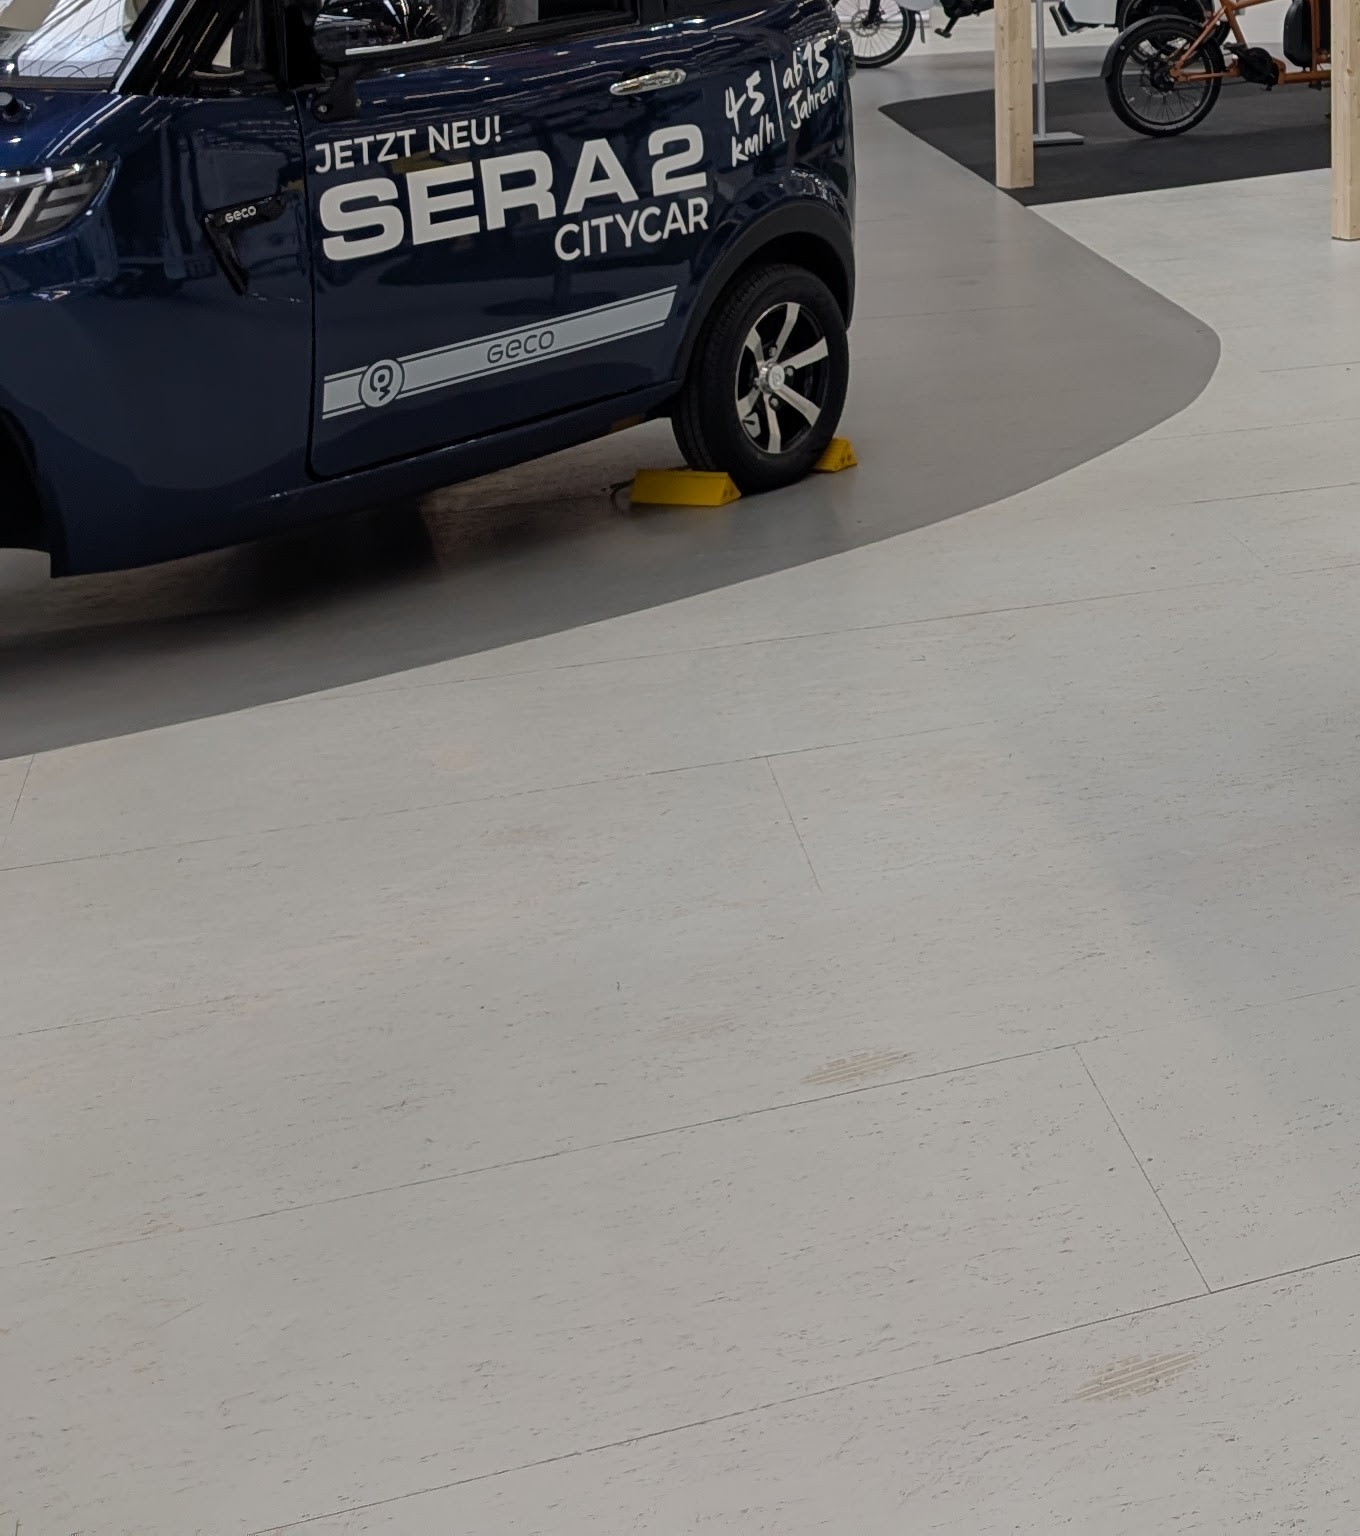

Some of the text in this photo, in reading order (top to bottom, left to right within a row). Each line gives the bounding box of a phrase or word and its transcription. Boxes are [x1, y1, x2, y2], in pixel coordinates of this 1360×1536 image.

[725, 69, 765, 135] 45
[787, 80, 837, 129] Jahren
[314, 115, 502, 174] JETZT NEU!
[731, 113, 775, 168] km/h
[318, 123, 708, 262] SERA 2
[554, 196, 709, 262] CITYCAR
